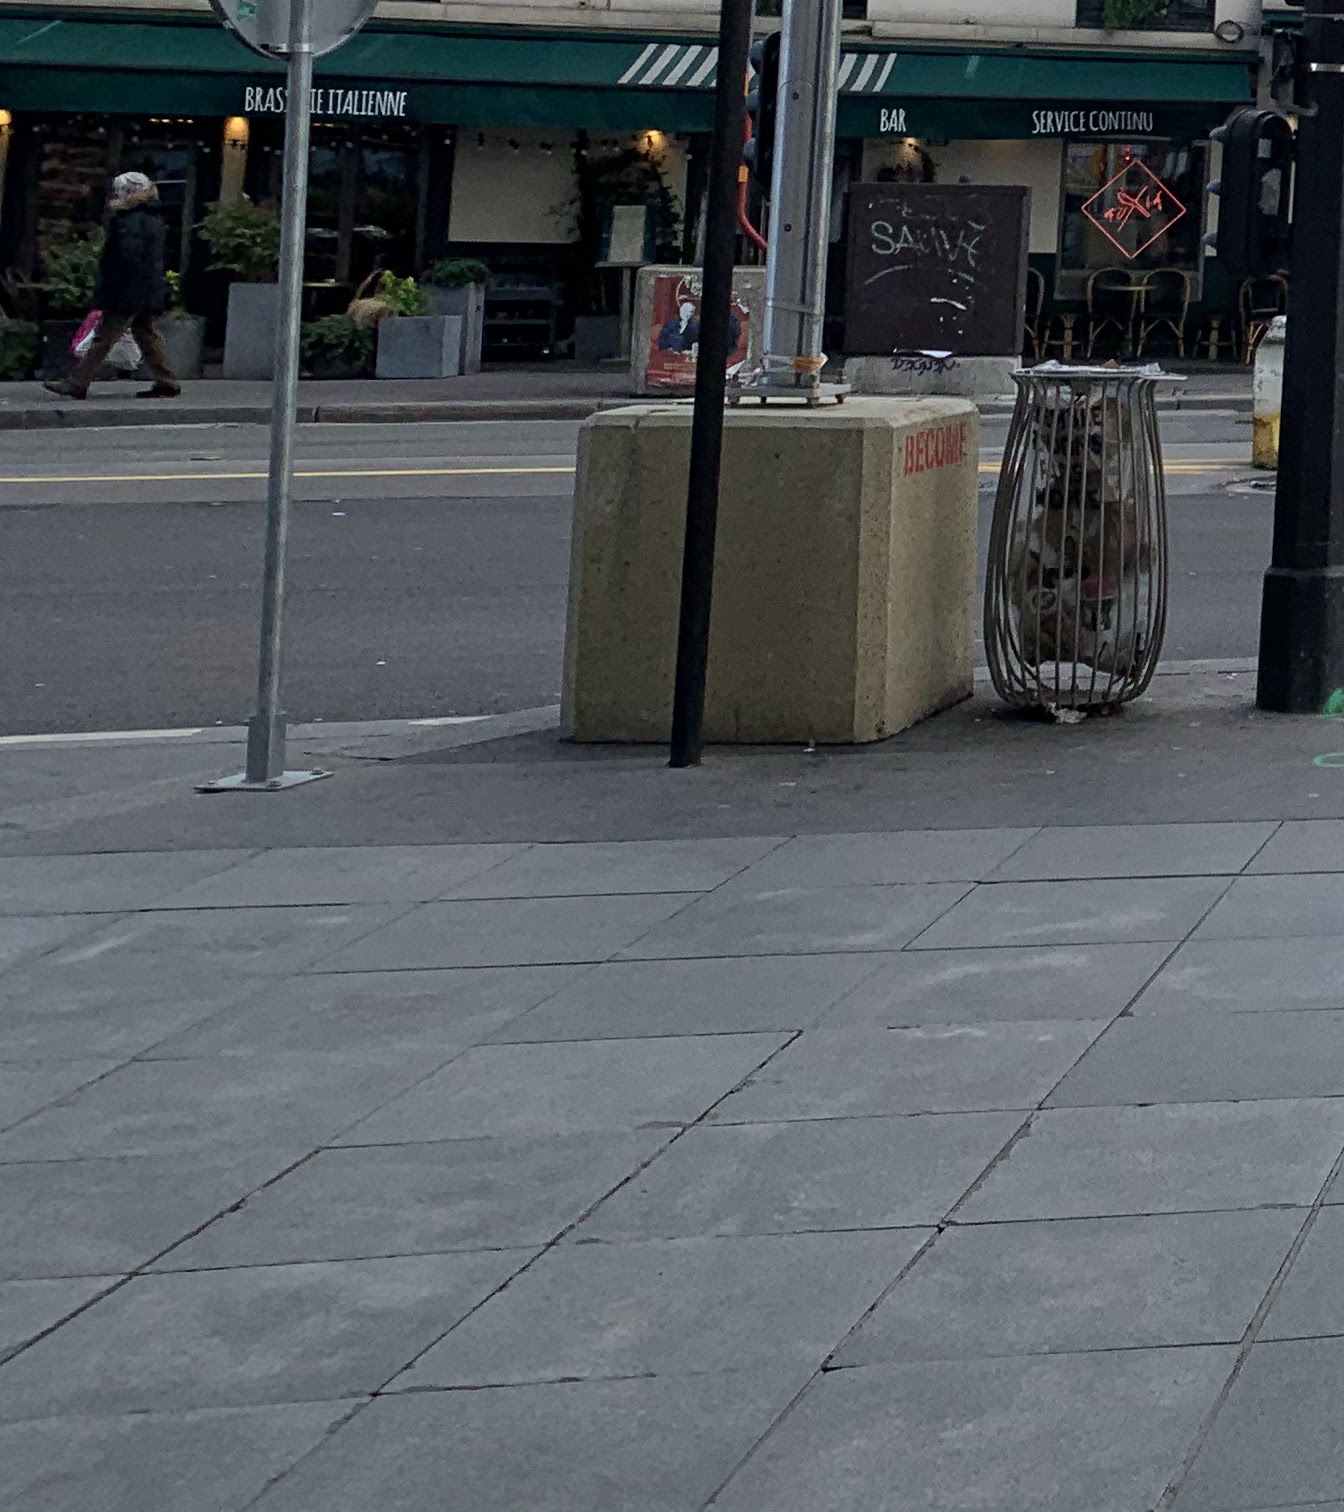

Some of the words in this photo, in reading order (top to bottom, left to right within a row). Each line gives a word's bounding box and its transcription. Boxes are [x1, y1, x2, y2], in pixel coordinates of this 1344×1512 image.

[244, 87, 324, 114] BRASIE
[327, 89, 408, 117] ITALIENNE
[880, 108, 906, 133] BAR
[1032, 110, 1086, 134] SERVICE
[1089, 110, 1153, 132] CONTINU
[905, 422, 968, 477] BECOME
